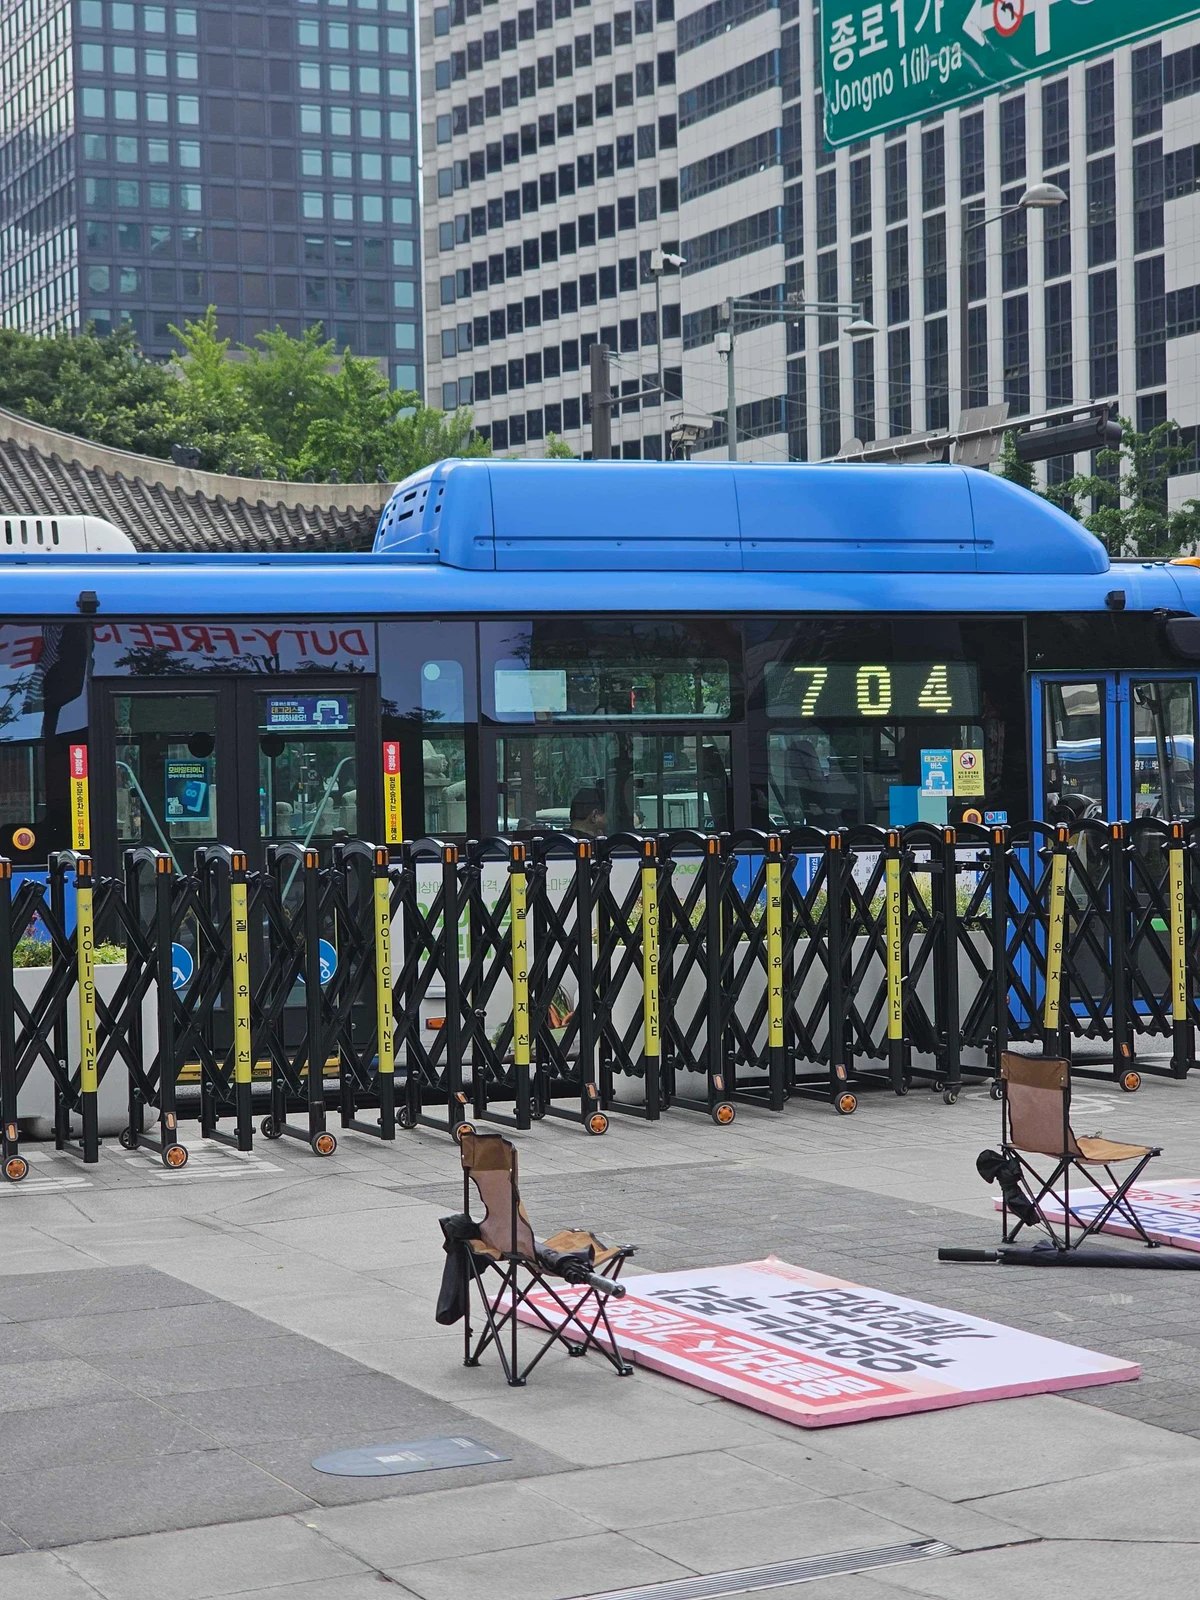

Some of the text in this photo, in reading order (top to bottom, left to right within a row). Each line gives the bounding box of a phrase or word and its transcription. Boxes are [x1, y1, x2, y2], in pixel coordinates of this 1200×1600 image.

[829, 0, 945, 72] 종로1가
[830, 41, 963, 116] Jongno 1(il)-ga
[793, 665, 953, 716] 704
[892, 892, 901, 961] POLICE
[1176, 880, 1185, 946] POLICE
[82, 925, 95, 1071] POLICE LINE
[235, 919, 251, 1063] 질서유지선
[381, 913, 392, 1053] POLICE LINE
[516, 907, 529, 1046] 질서유지선
[648, 902, 658, 1038] POLICE LINE
[647, 1286, 952, 1372] 유암코는 즉각
[772, 1289, 994, 1345] 개입하라
[686, 1336, 881, 1398] 홈플러스
